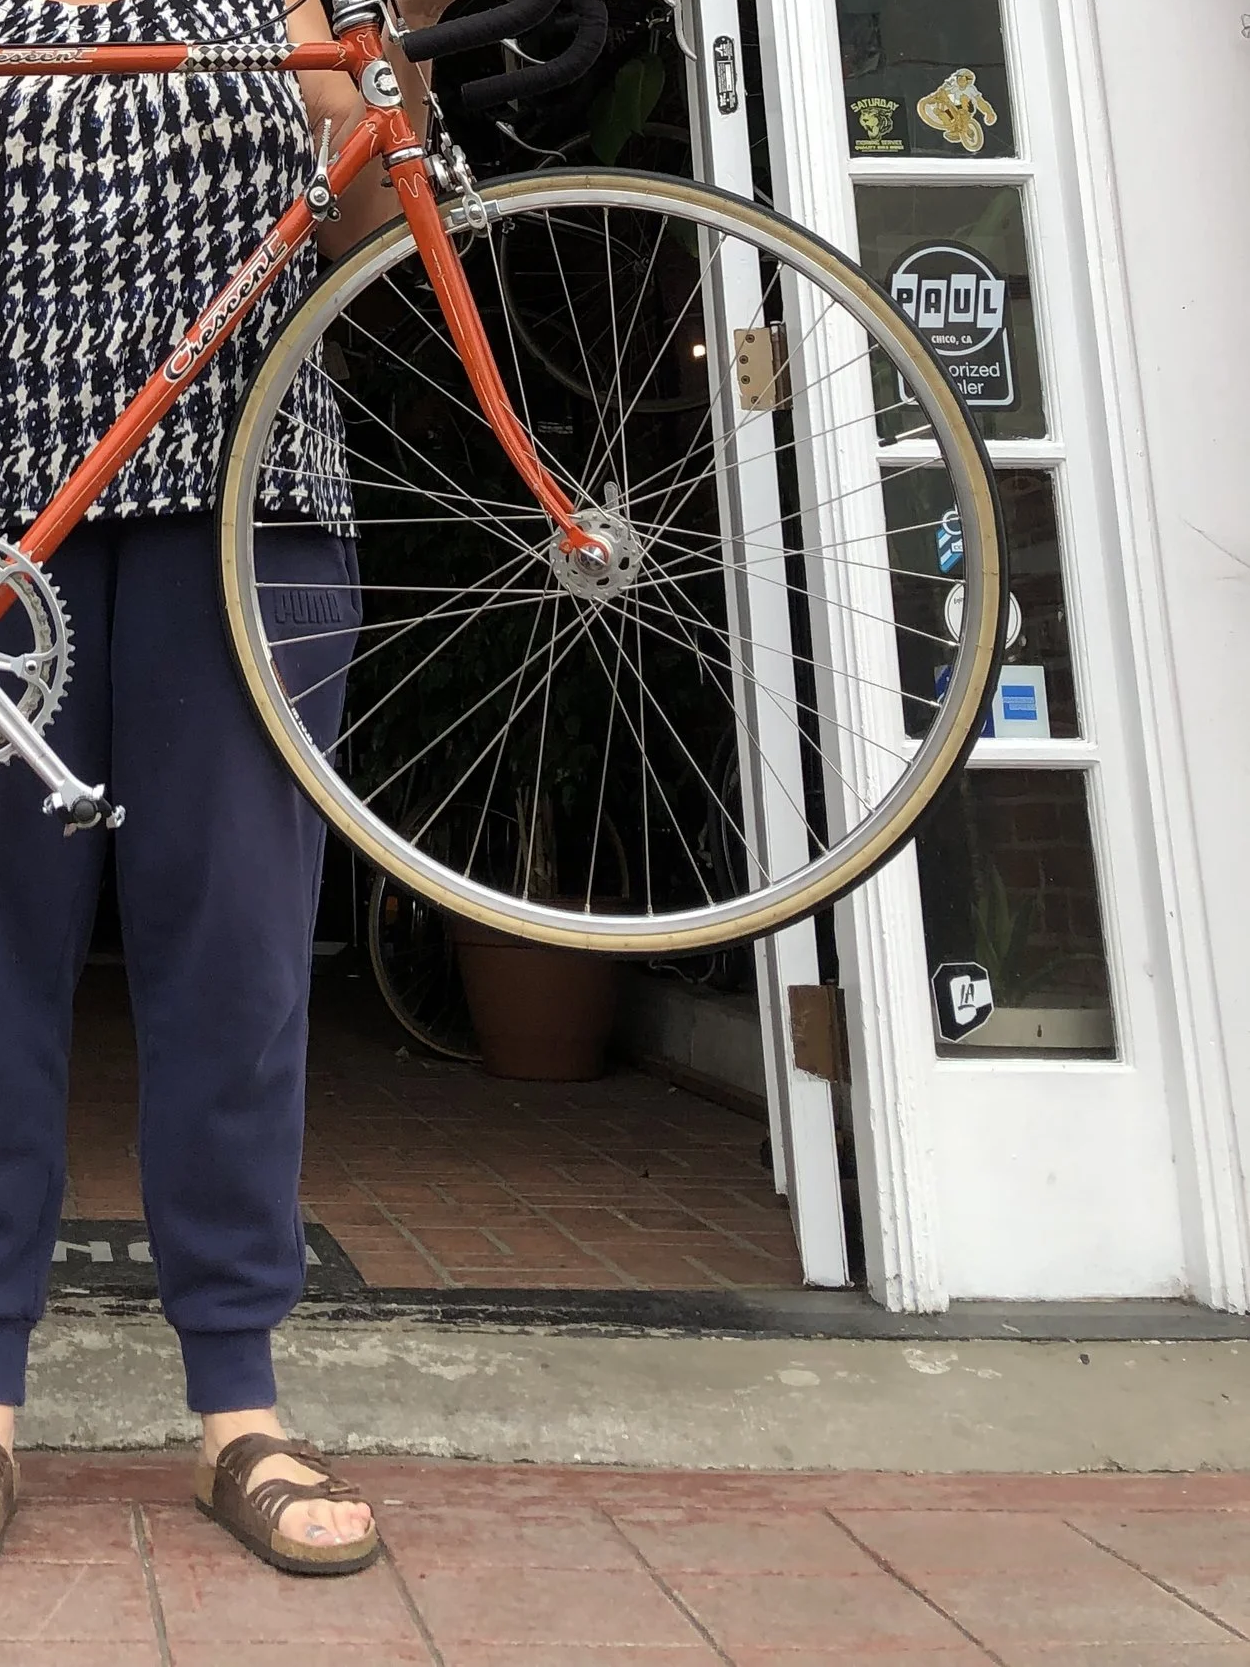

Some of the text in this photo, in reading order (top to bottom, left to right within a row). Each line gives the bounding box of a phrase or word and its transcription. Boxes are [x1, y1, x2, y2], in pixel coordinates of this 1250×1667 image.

[850, 97, 900, 113] SATURDAY
[163, 229, 288, 383] Crescent
[896, 287, 999, 314] PAUL
[931, 335, 973, 346] CHICO, CA
[948, 362, 1000, 377] orized
